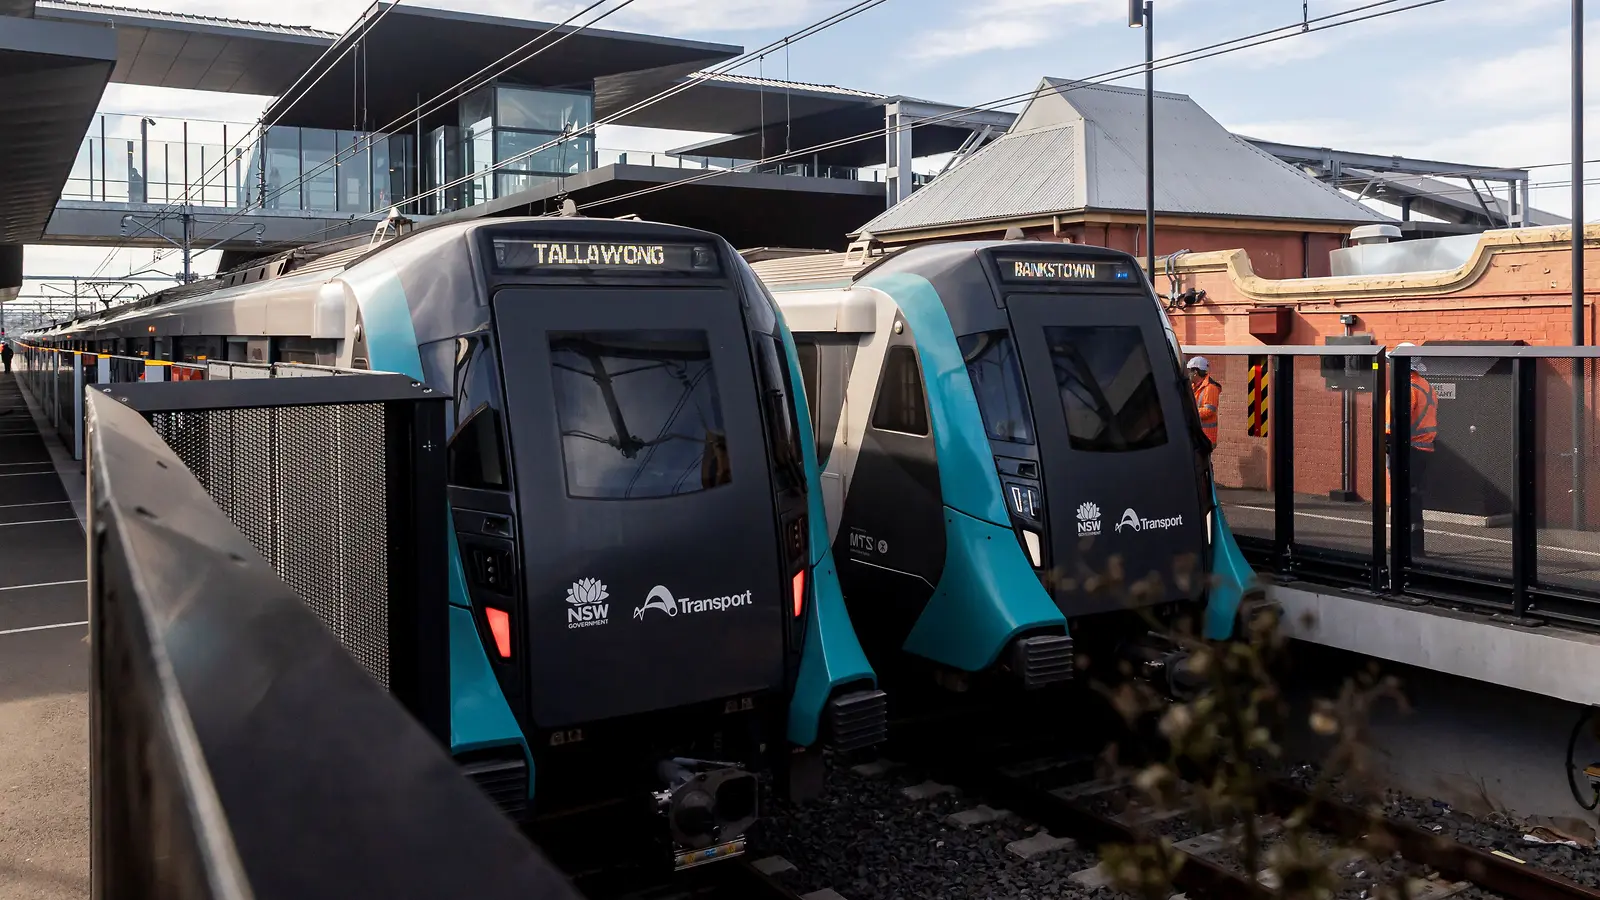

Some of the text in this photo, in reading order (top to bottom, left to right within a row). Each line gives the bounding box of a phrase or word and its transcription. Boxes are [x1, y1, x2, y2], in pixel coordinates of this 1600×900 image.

[533, 243, 665, 265] TALLAWONG
[1014, 261, 1095, 278] BANKSTOWN
[1077, 520, 1101, 532] NSW
[1140, 514, 1183, 530] Transport
[850, 532, 873, 550] MTS
[678, 589, 753, 614] Transport
[567, 603, 610, 623] NSW
[568, 618, 609, 629] GOVERNMENT
